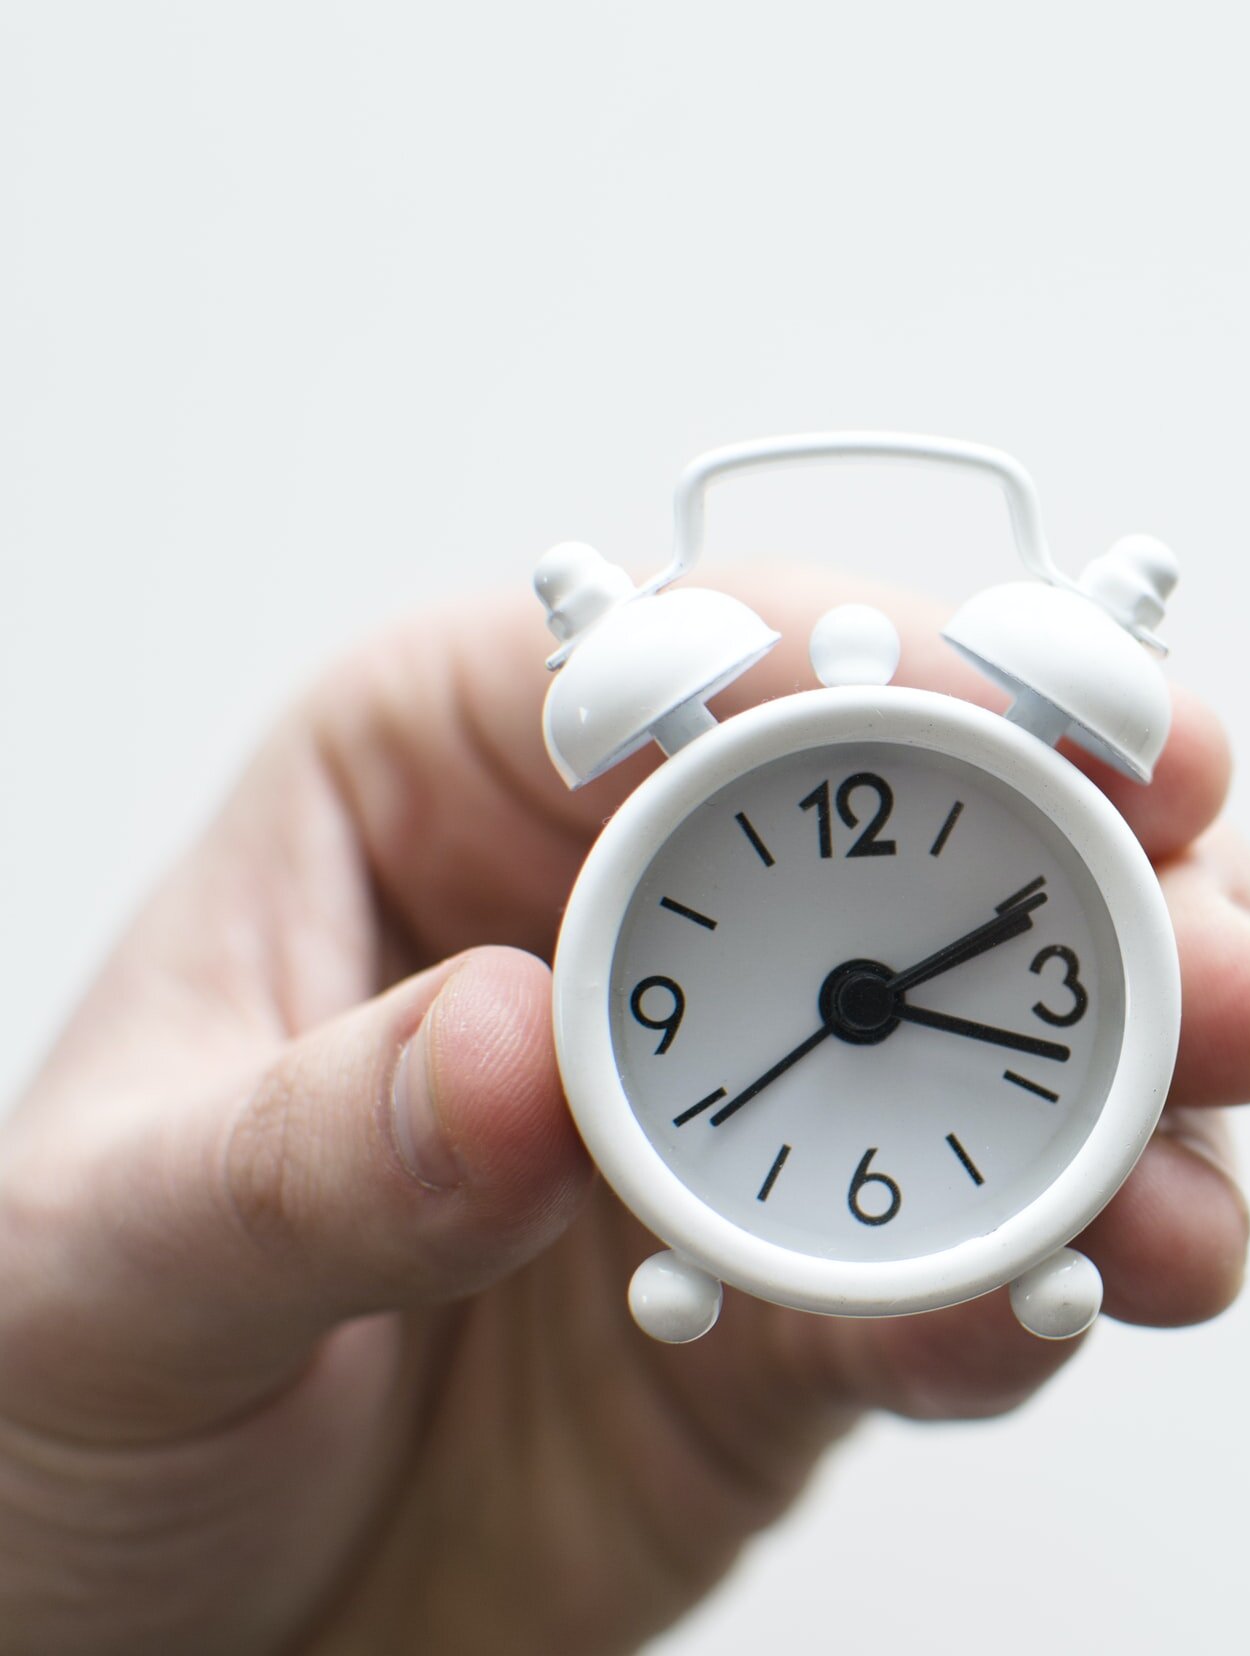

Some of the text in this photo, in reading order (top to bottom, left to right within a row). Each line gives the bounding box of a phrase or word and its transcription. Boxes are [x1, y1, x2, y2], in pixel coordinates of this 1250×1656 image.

[798, 771, 897, 859] 12
[629, 974, 686, 1056] 9
[1028, 943, 1089, 1028] 3
[847, 1147, 902, 1227] 6
